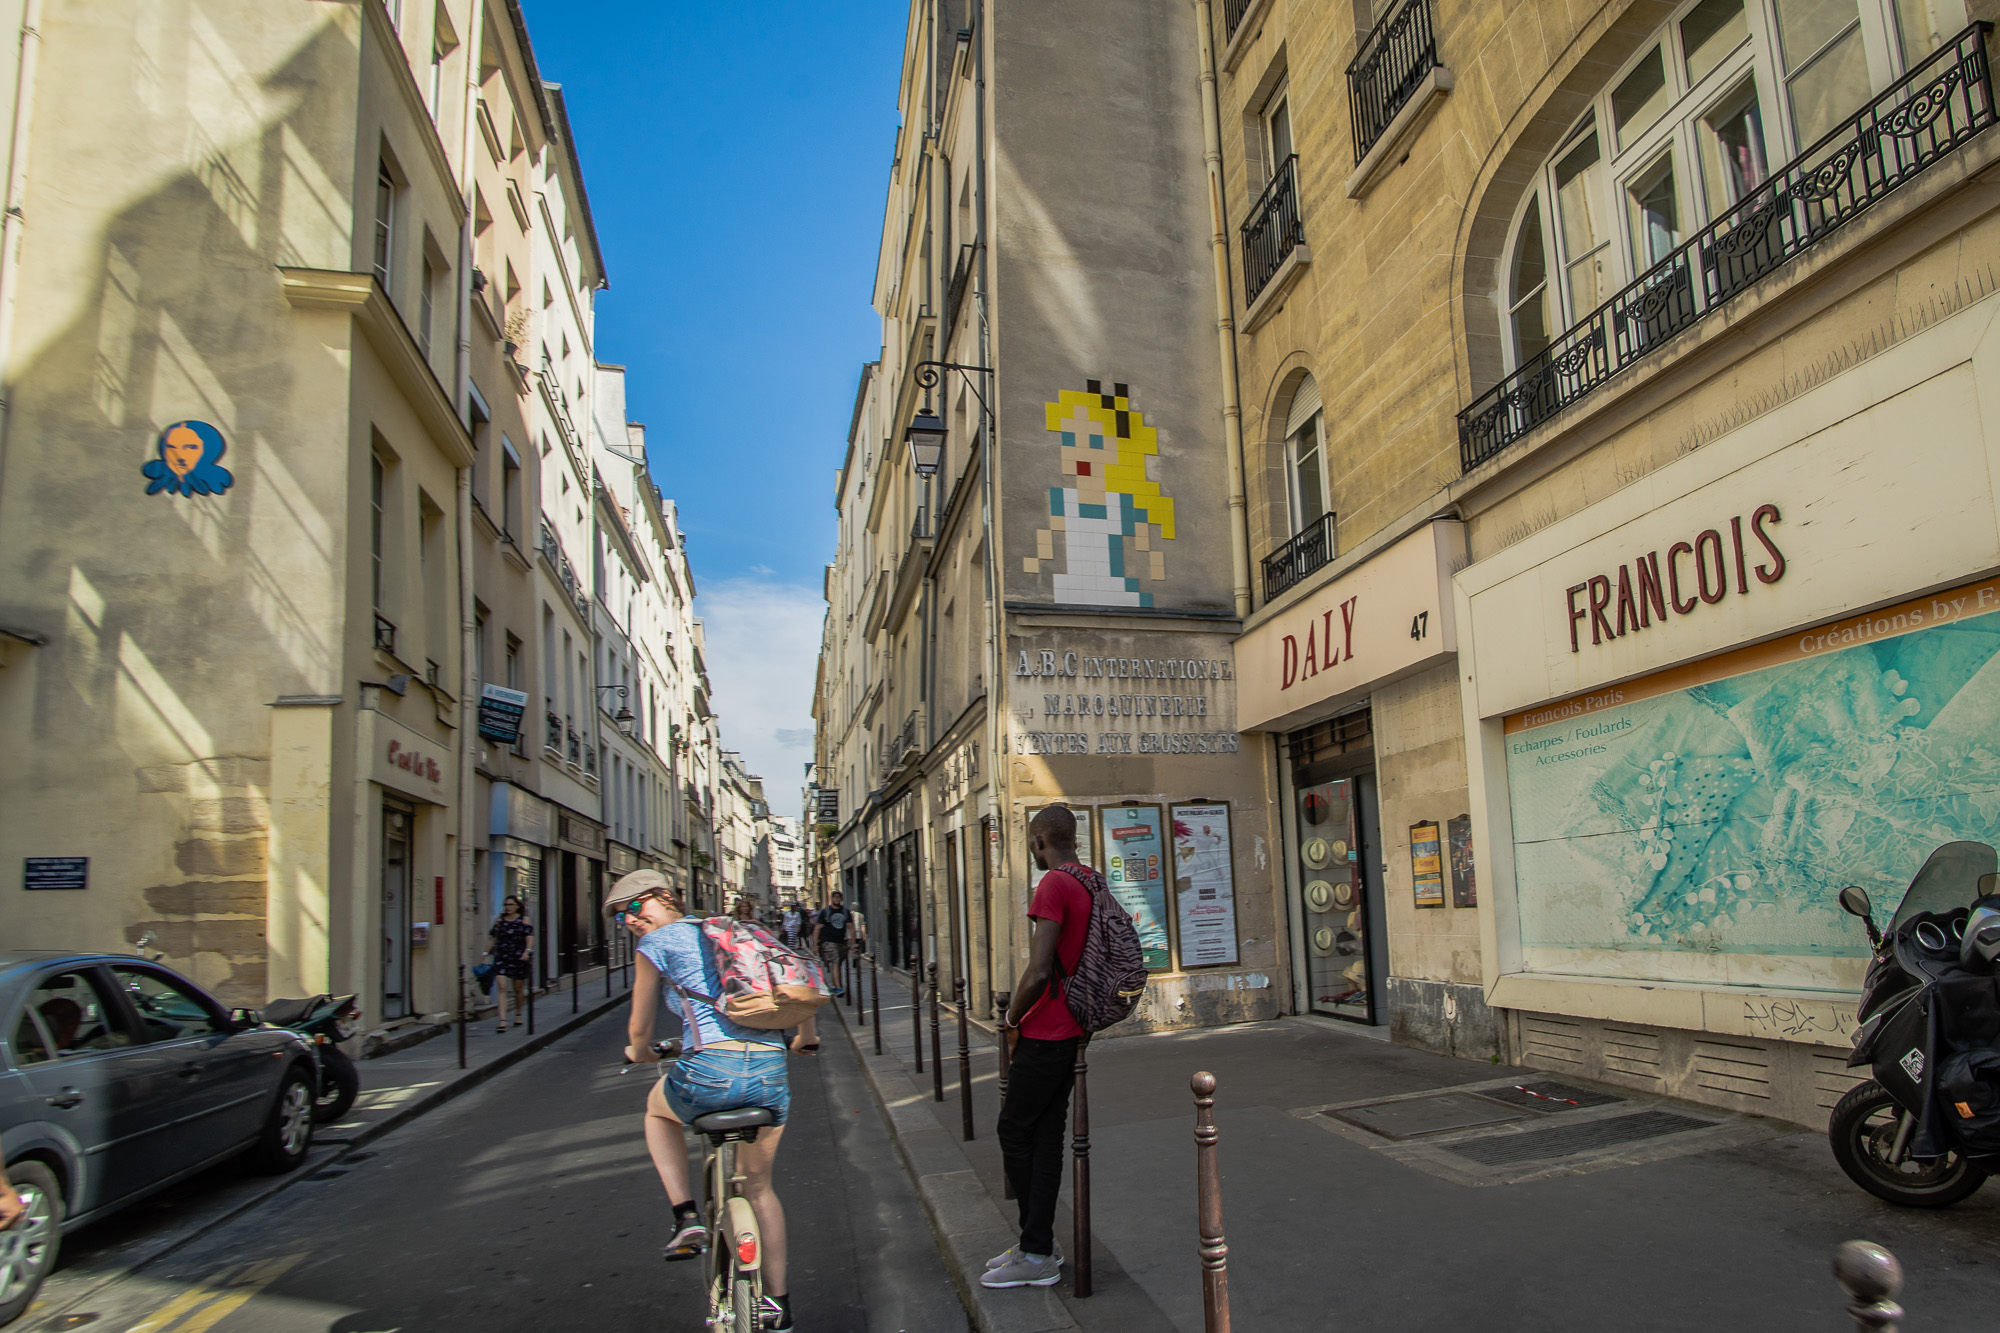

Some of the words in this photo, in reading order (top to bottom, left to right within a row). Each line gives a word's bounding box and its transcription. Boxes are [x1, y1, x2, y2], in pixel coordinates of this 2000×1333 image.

[1566, 504, 1786, 652] FRANCOIS
[1281, 595, 1357, 691] DALY
[1410, 610, 1428, 641] 47
[1800, 608, 1923, 653] Créations
[1932, 597, 1967, 624] by
[1016, 649, 1077, 677] A.B.C
[1083, 656, 1232, 680] INTERNATIONAL
[1044, 694, 1207, 716] MAROQUINERIE
[1523, 701, 1582, 727] Francois
[1585, 690, 1623, 711] Paris
[1015, 732, 1088, 755] VENTES
[1096, 733, 1131, 754] AUX
[1138, 732, 1239, 755] GROSSISTES
[1513, 735, 1563, 754] Echarpes
[1575, 716, 1632, 740] Foulards
[1535, 744, 1607, 766] Accessories
